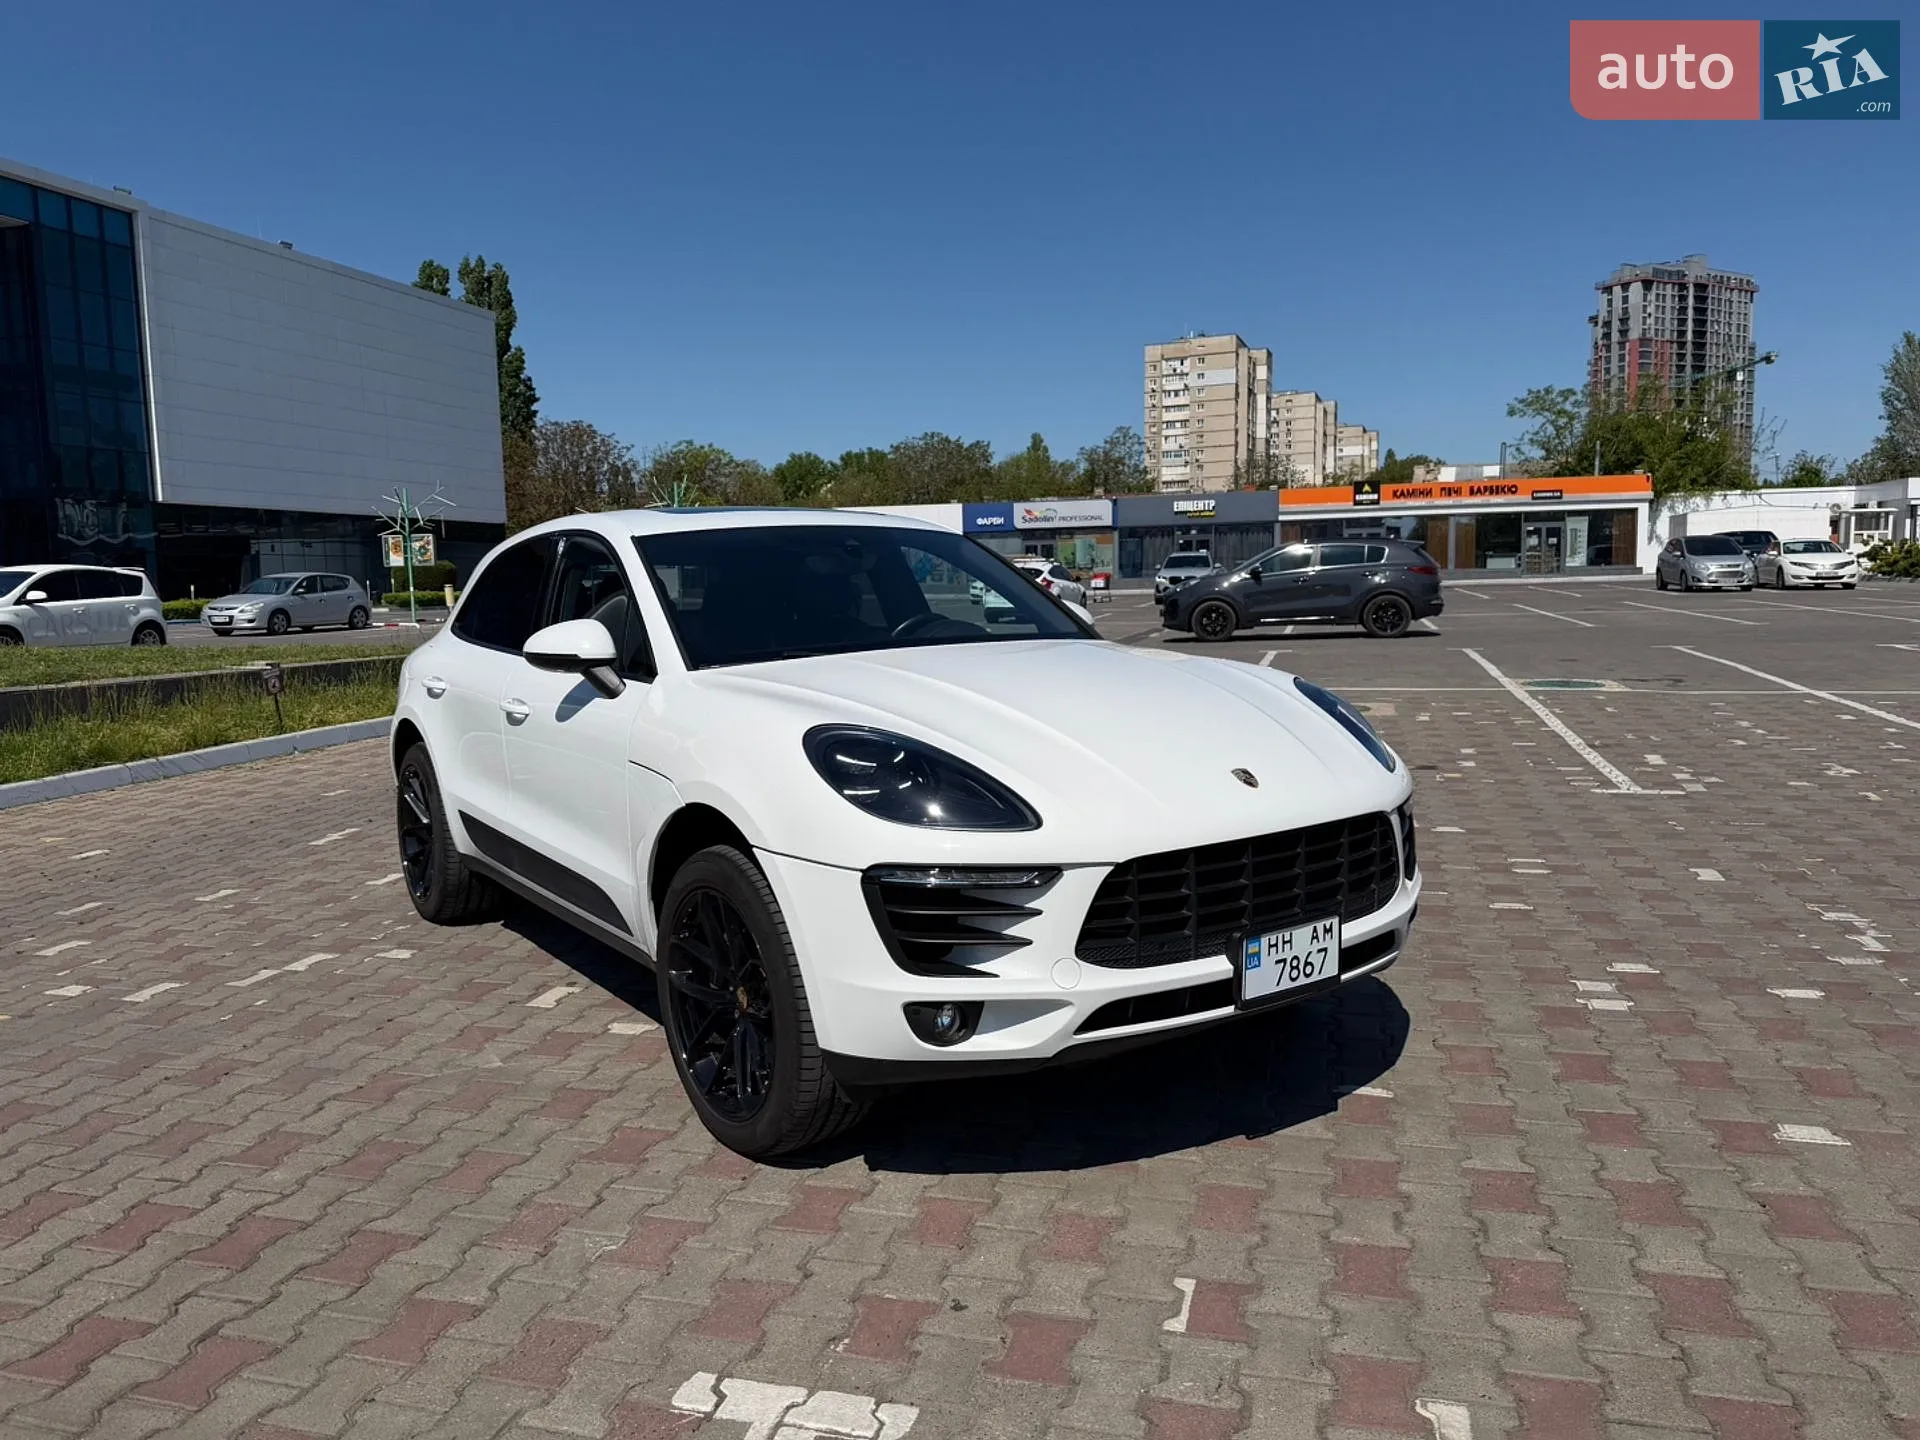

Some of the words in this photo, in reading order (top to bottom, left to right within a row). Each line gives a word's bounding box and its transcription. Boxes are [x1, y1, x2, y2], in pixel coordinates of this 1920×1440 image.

[1469, 484, 1518, 496] БАРБЕКЮ
[1310, 921, 1334, 945] AM
[1274, 947, 1328, 987] 7867
